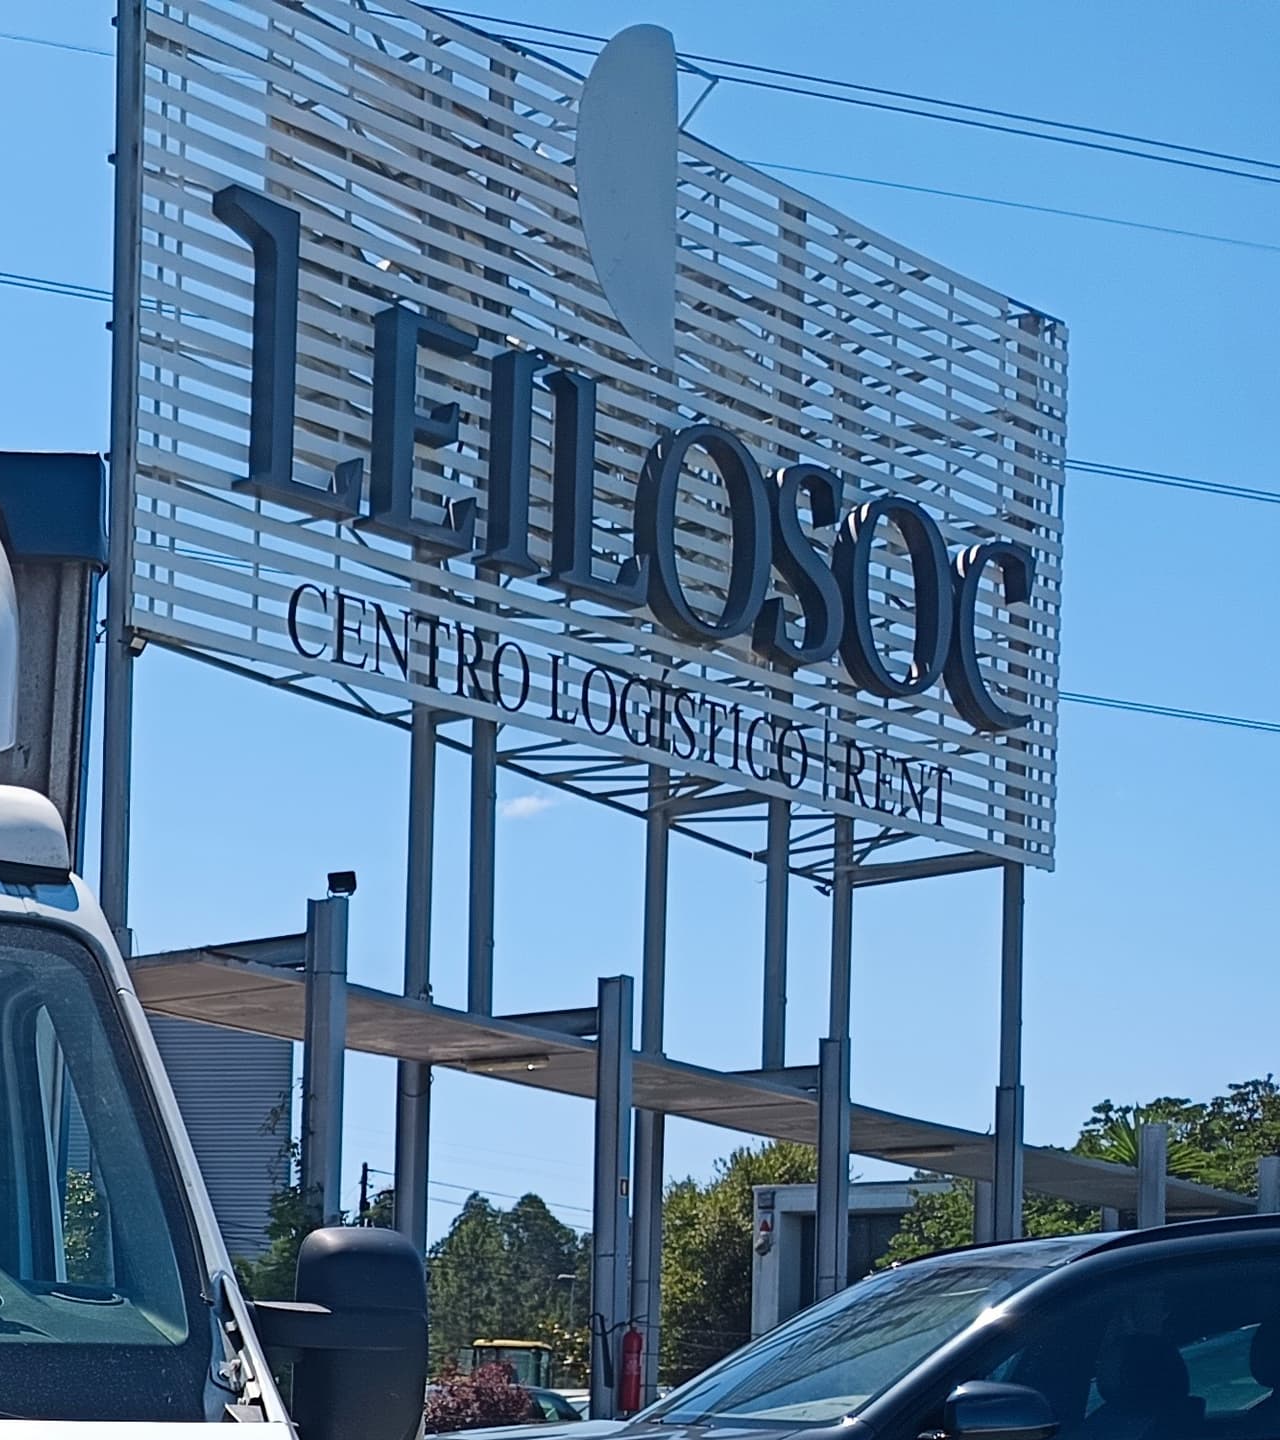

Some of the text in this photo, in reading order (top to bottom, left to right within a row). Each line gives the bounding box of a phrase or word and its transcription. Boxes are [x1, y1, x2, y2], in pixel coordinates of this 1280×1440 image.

[212, 183, 1037, 732] LEILOSOC
[287, 583, 952, 827] CENTRO LOGÍSTICO RENT
